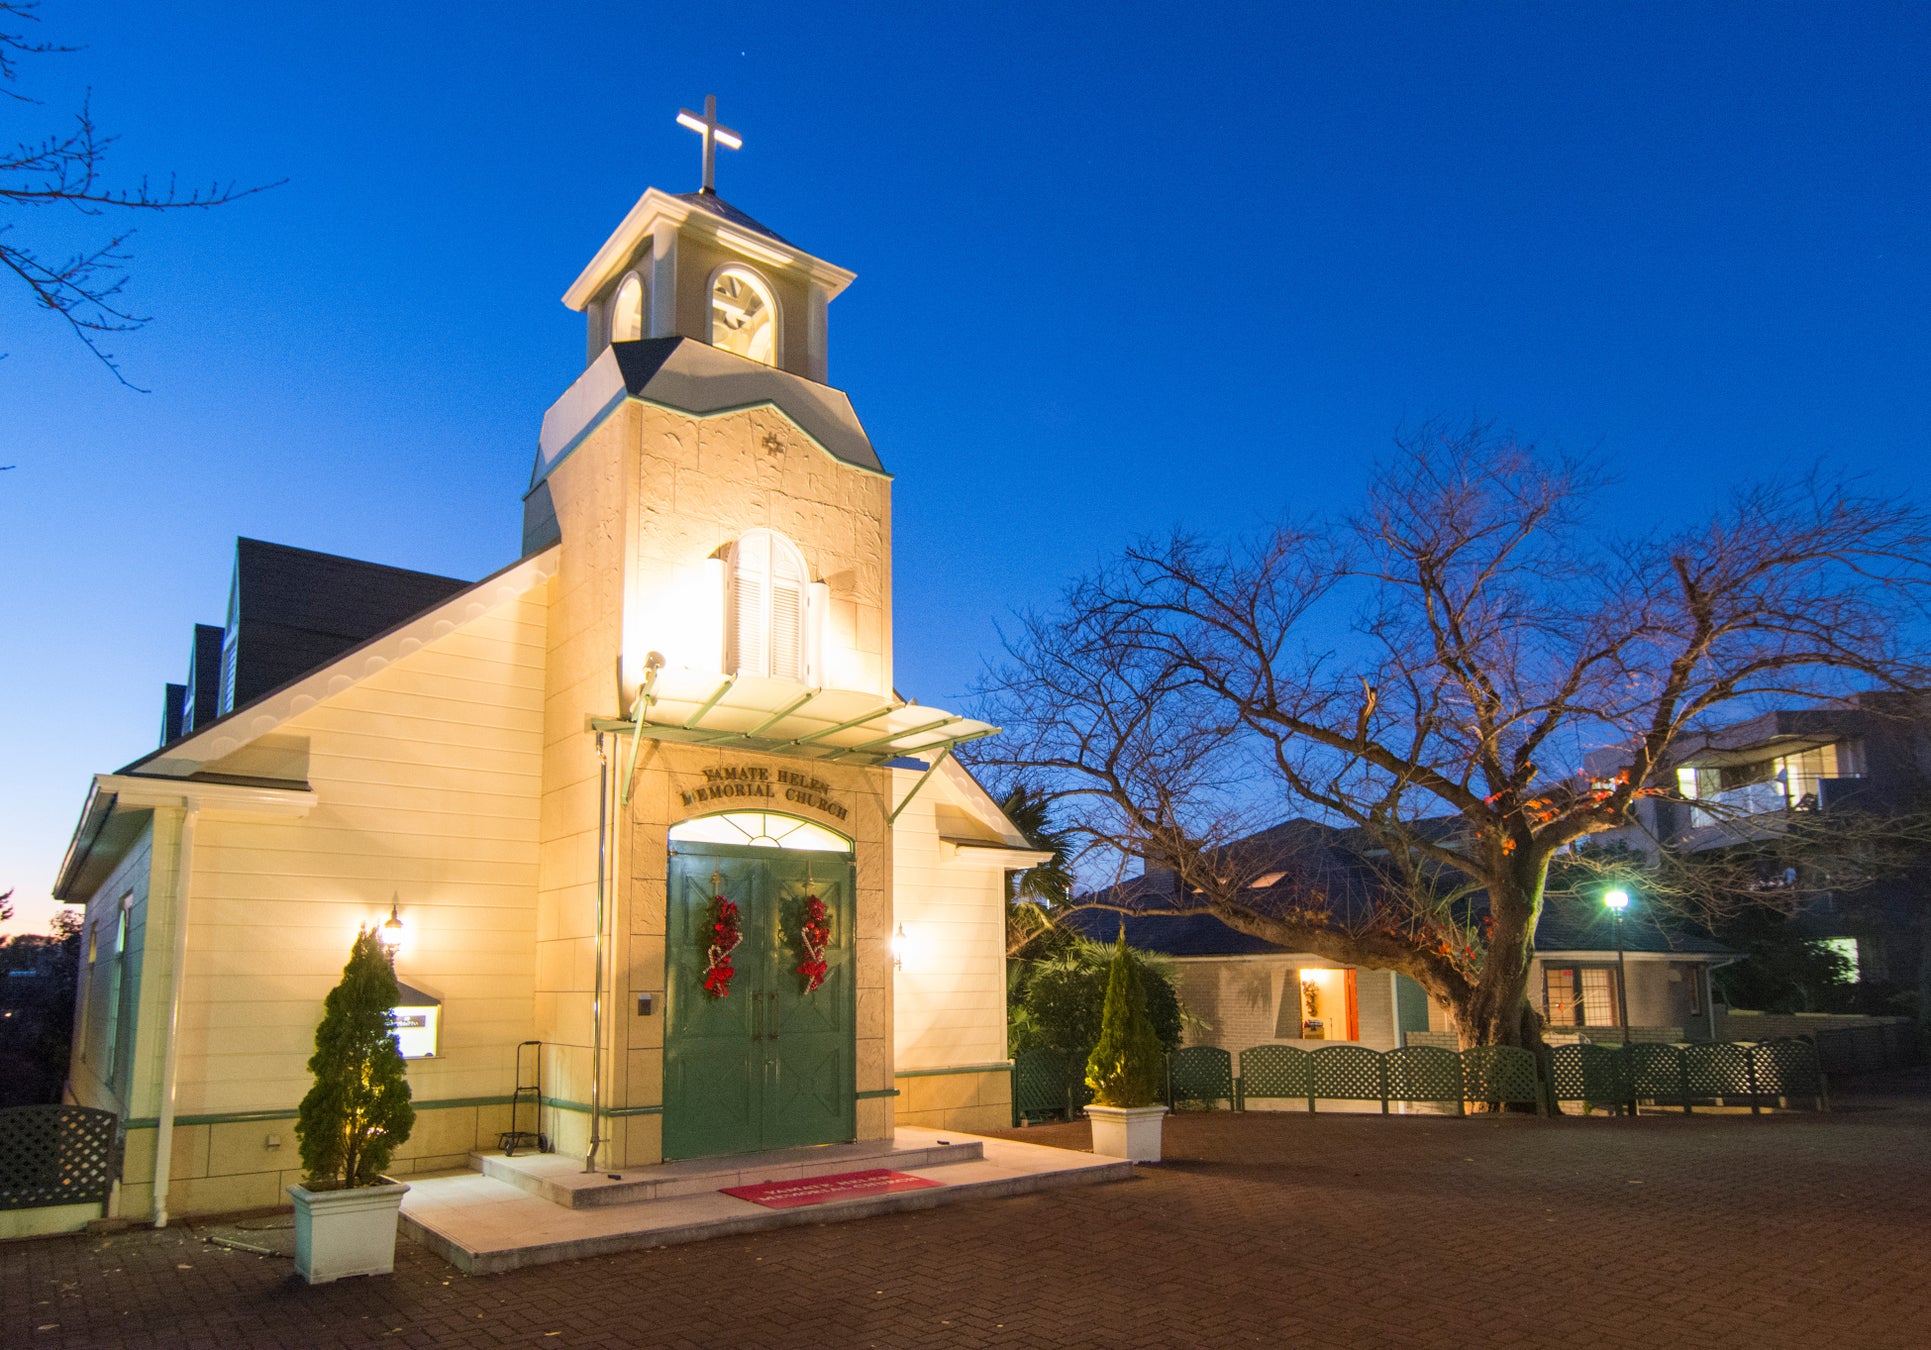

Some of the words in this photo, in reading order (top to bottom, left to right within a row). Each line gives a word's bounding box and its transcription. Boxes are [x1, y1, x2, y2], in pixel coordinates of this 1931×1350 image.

[702, 767, 769, 782] YAMATE
[778, 769, 830, 796] HELEN
[681, 783, 775, 807] MEMORIAL
[785, 788, 848, 820] CHURCH
